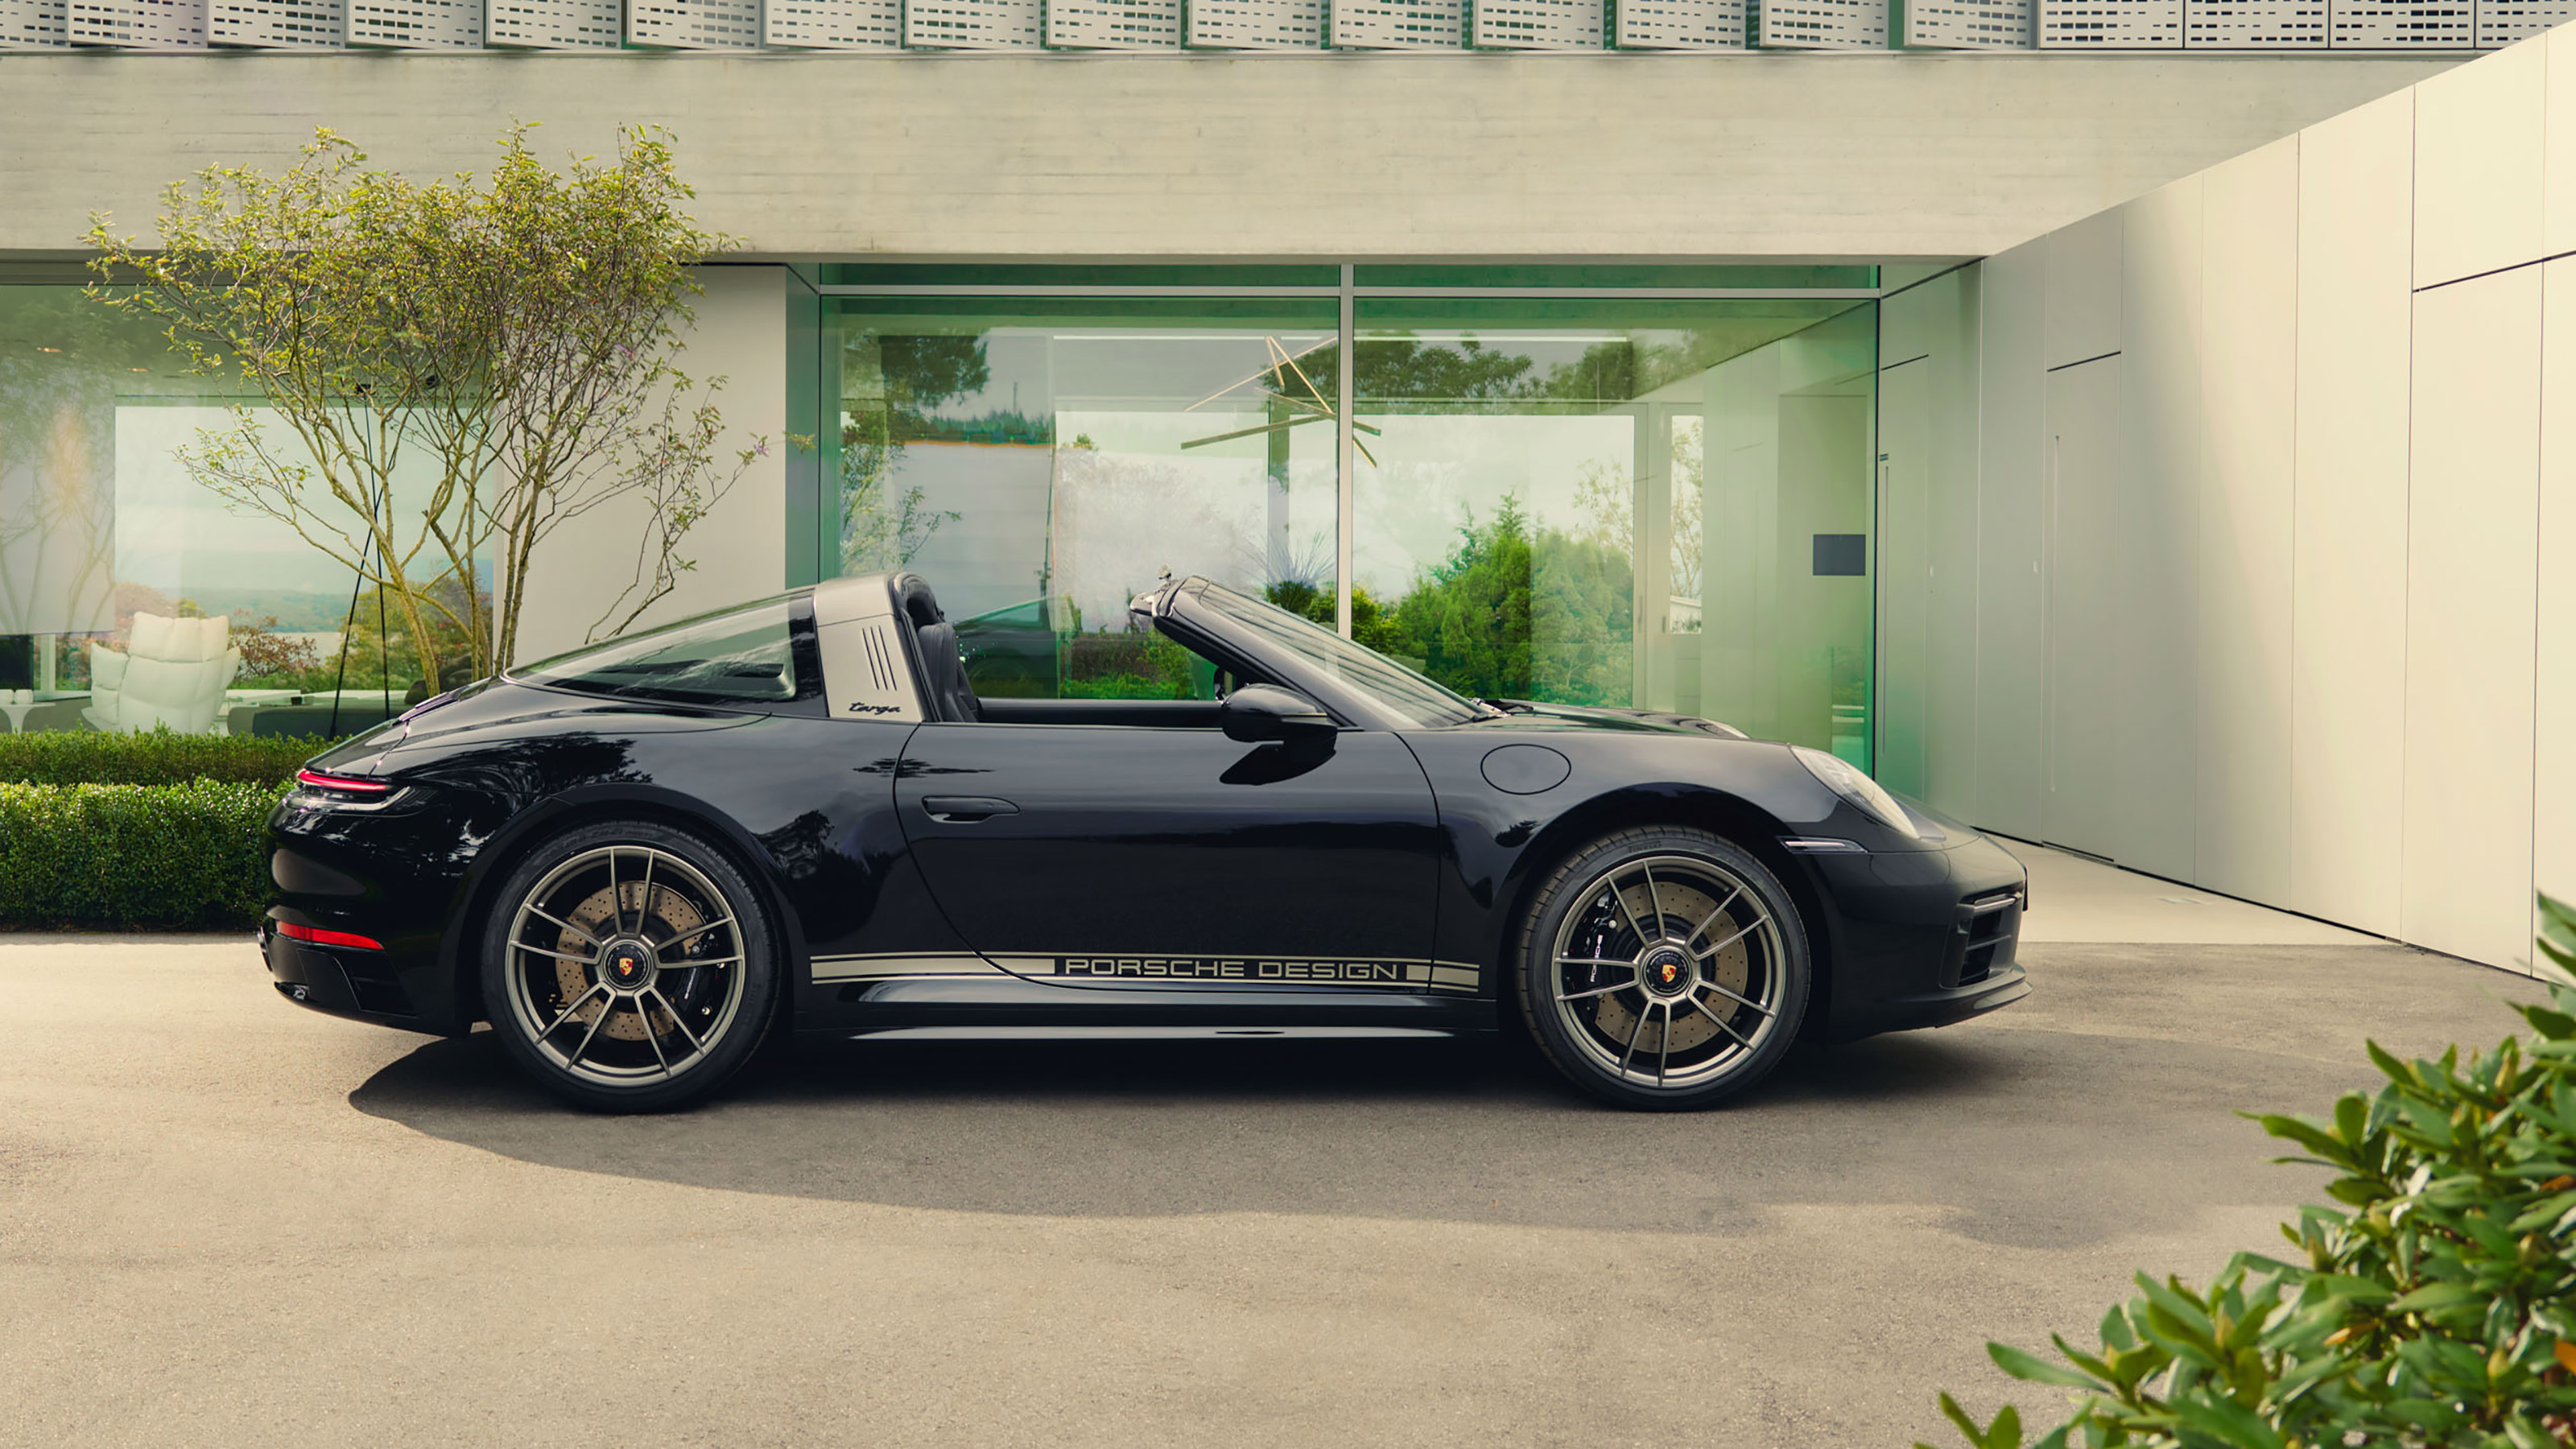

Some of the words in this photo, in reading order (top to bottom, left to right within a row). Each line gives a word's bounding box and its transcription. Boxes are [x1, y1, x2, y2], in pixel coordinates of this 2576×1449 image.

[848, 701, 901, 715] targa
[1065, 959, 1245, 976] PORSCHE
[1258, 961, 1397, 980] DESIGN
